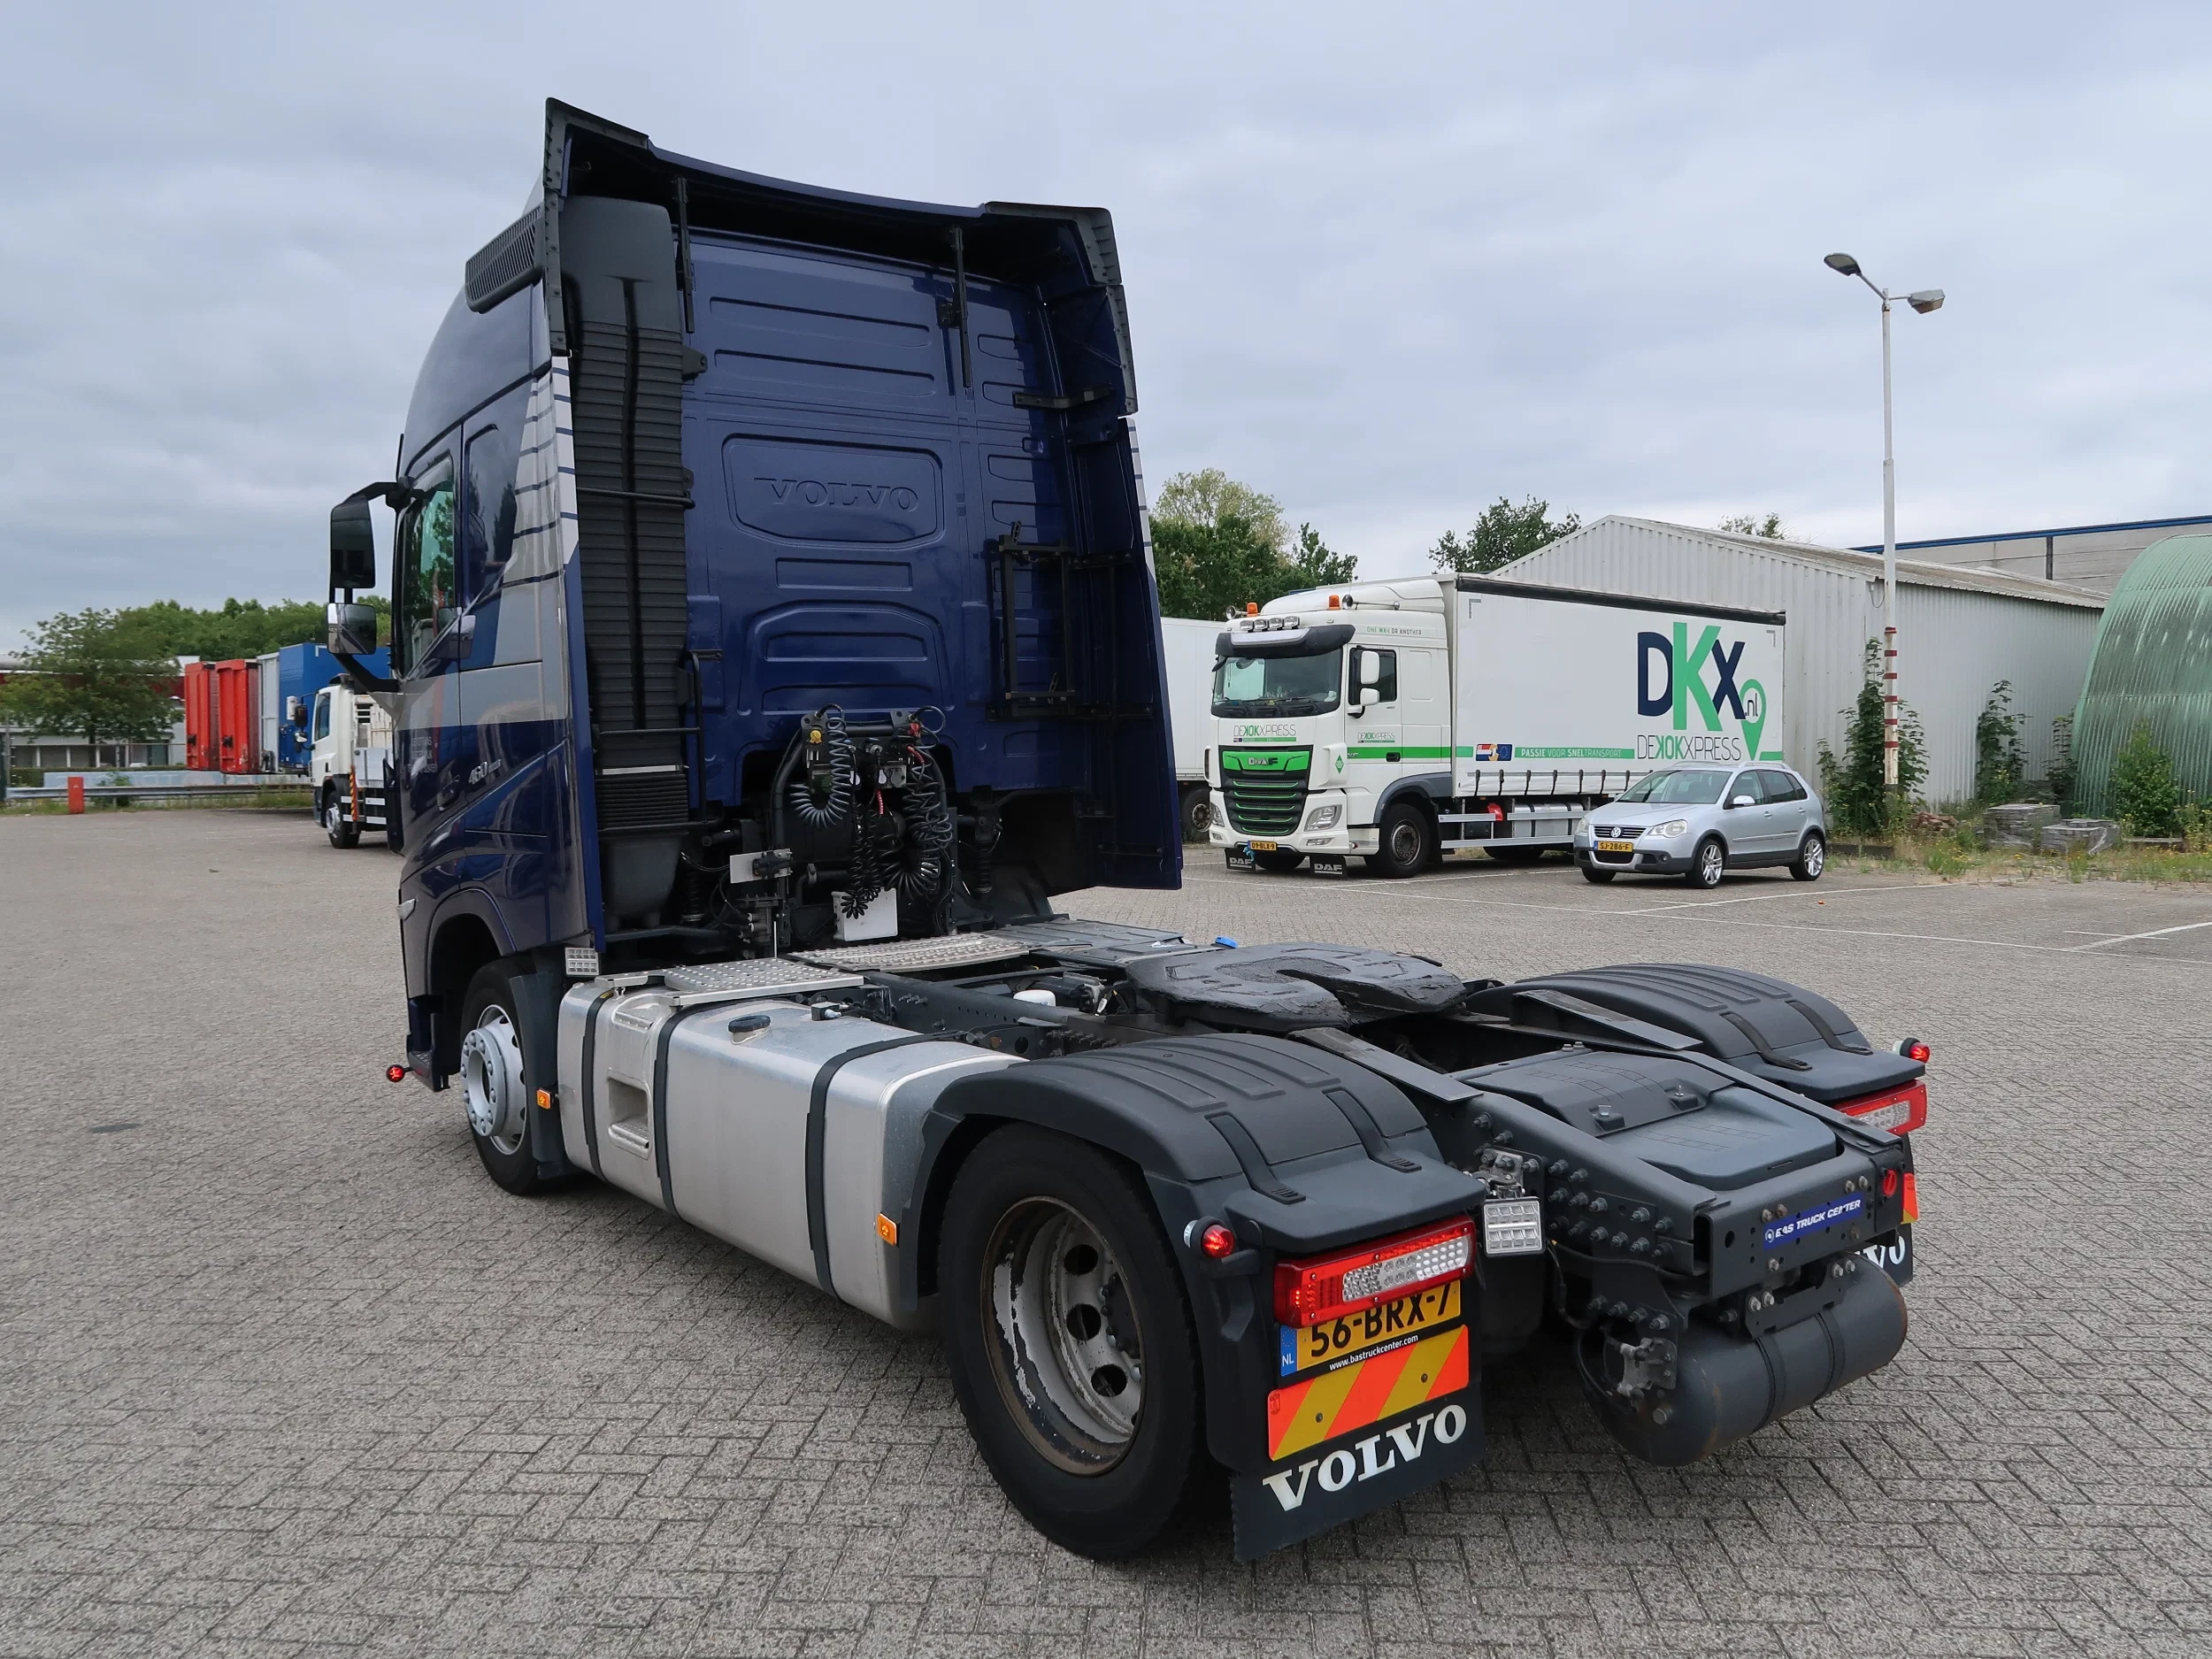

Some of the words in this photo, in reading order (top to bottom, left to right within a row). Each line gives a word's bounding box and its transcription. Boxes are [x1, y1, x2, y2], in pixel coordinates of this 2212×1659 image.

[754, 478, 918, 511] VOLVO
[1233, 724, 1296, 736] DEKOKXPRESS
[1522, 749, 1546, 757] PASSIE
[1548, 749, 1566, 757] VOOR
[1638, 735, 1741, 761] DEKOKXPRESS
[1248, 757, 1279, 765] DAF
[1796, 1212, 1825, 1229] TRUCK
[1310, 1282, 1452, 1357] 56-BRX-7
[1282, 1353, 1294, 1367] NL
[1329, 1333, 1419, 1371] www.bastruckcenter.com
[1262, 1404, 1467, 1512] VOLVO
